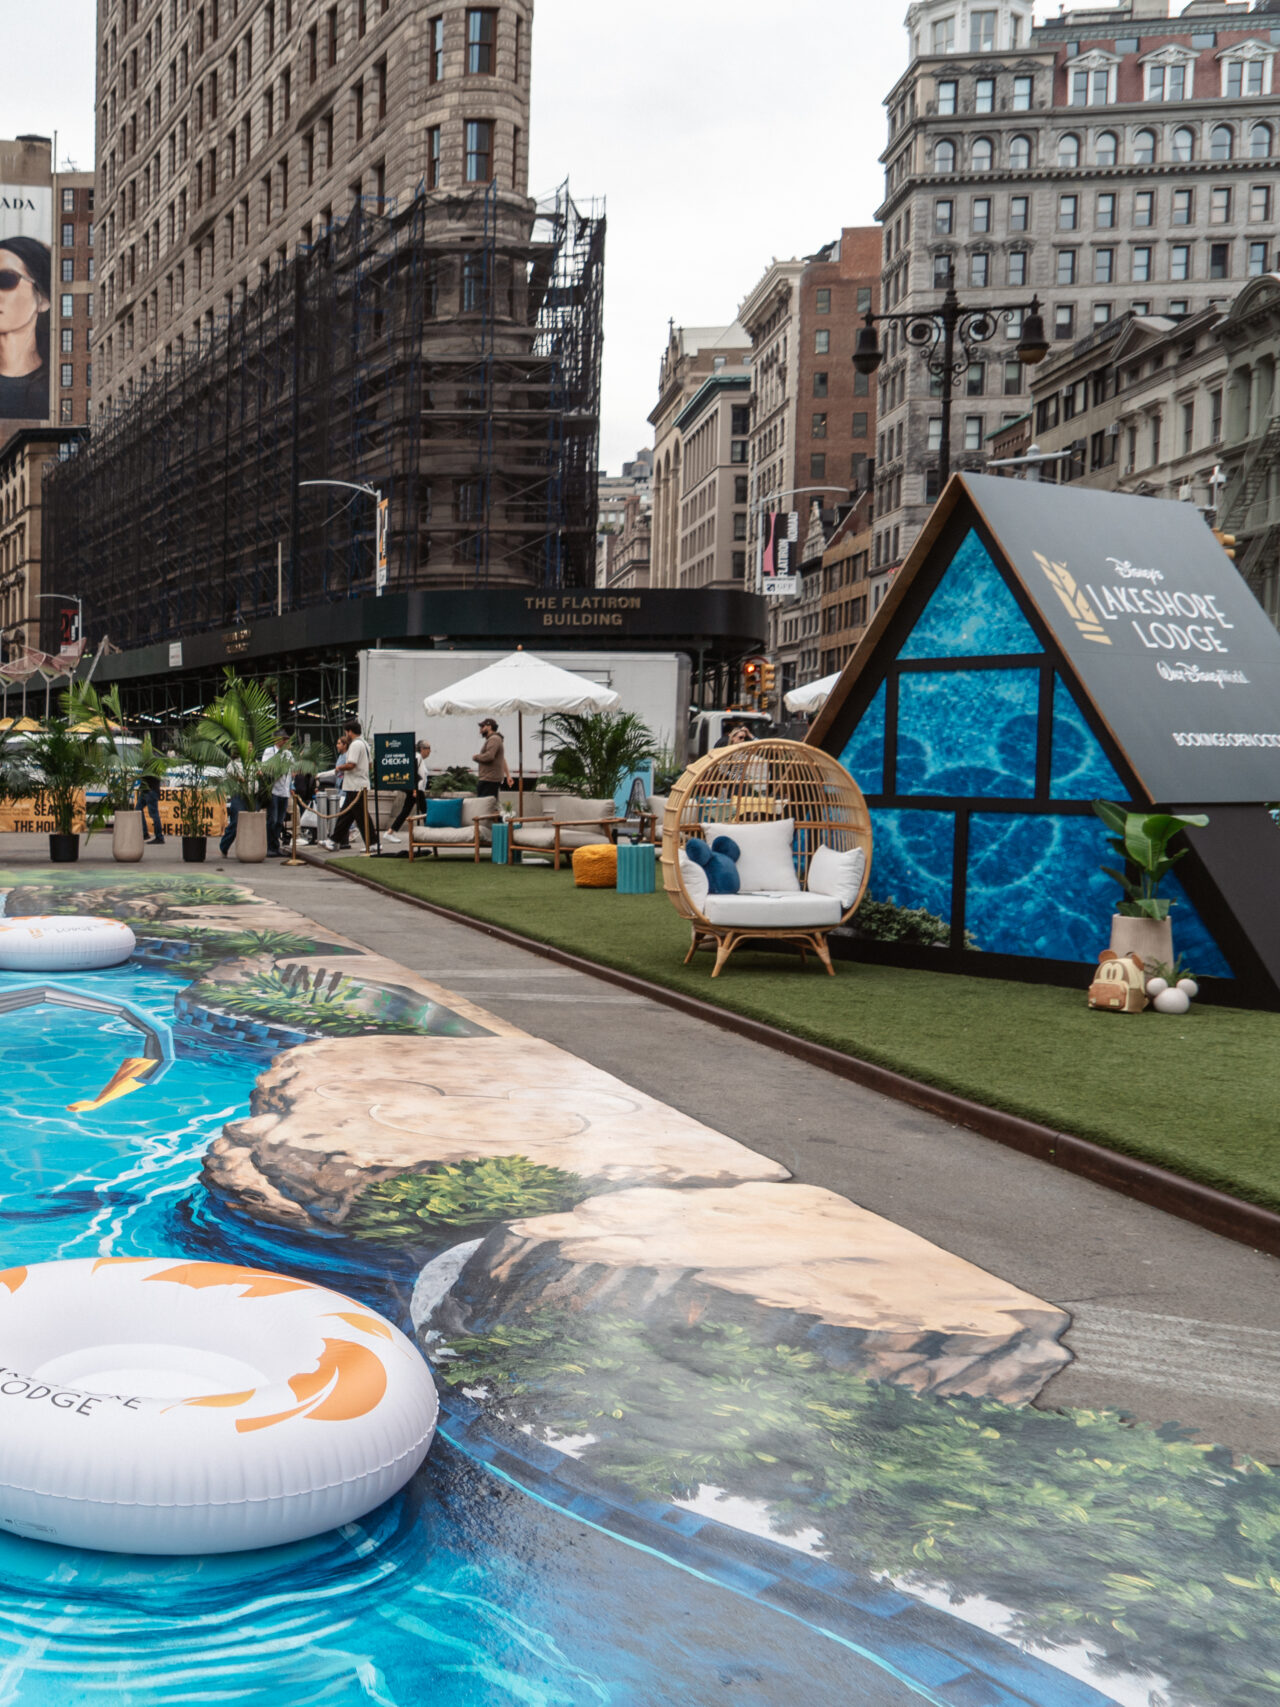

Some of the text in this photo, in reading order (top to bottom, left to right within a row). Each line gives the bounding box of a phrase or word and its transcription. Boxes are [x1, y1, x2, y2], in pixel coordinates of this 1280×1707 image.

[787, 512, 798, 541] NOMAD
[778, 538, 789, 577] FLATIRON
[524, 597, 641, 609] THE FLATIRON
[1086, 584, 1234, 628] LAKESHORE
[543, 613, 623, 626] BUILDING
[1132, 621, 1228, 652] LODGE
[381, 757, 410, 765] CHECK-IN
[14, 820, 33, 832] THE
